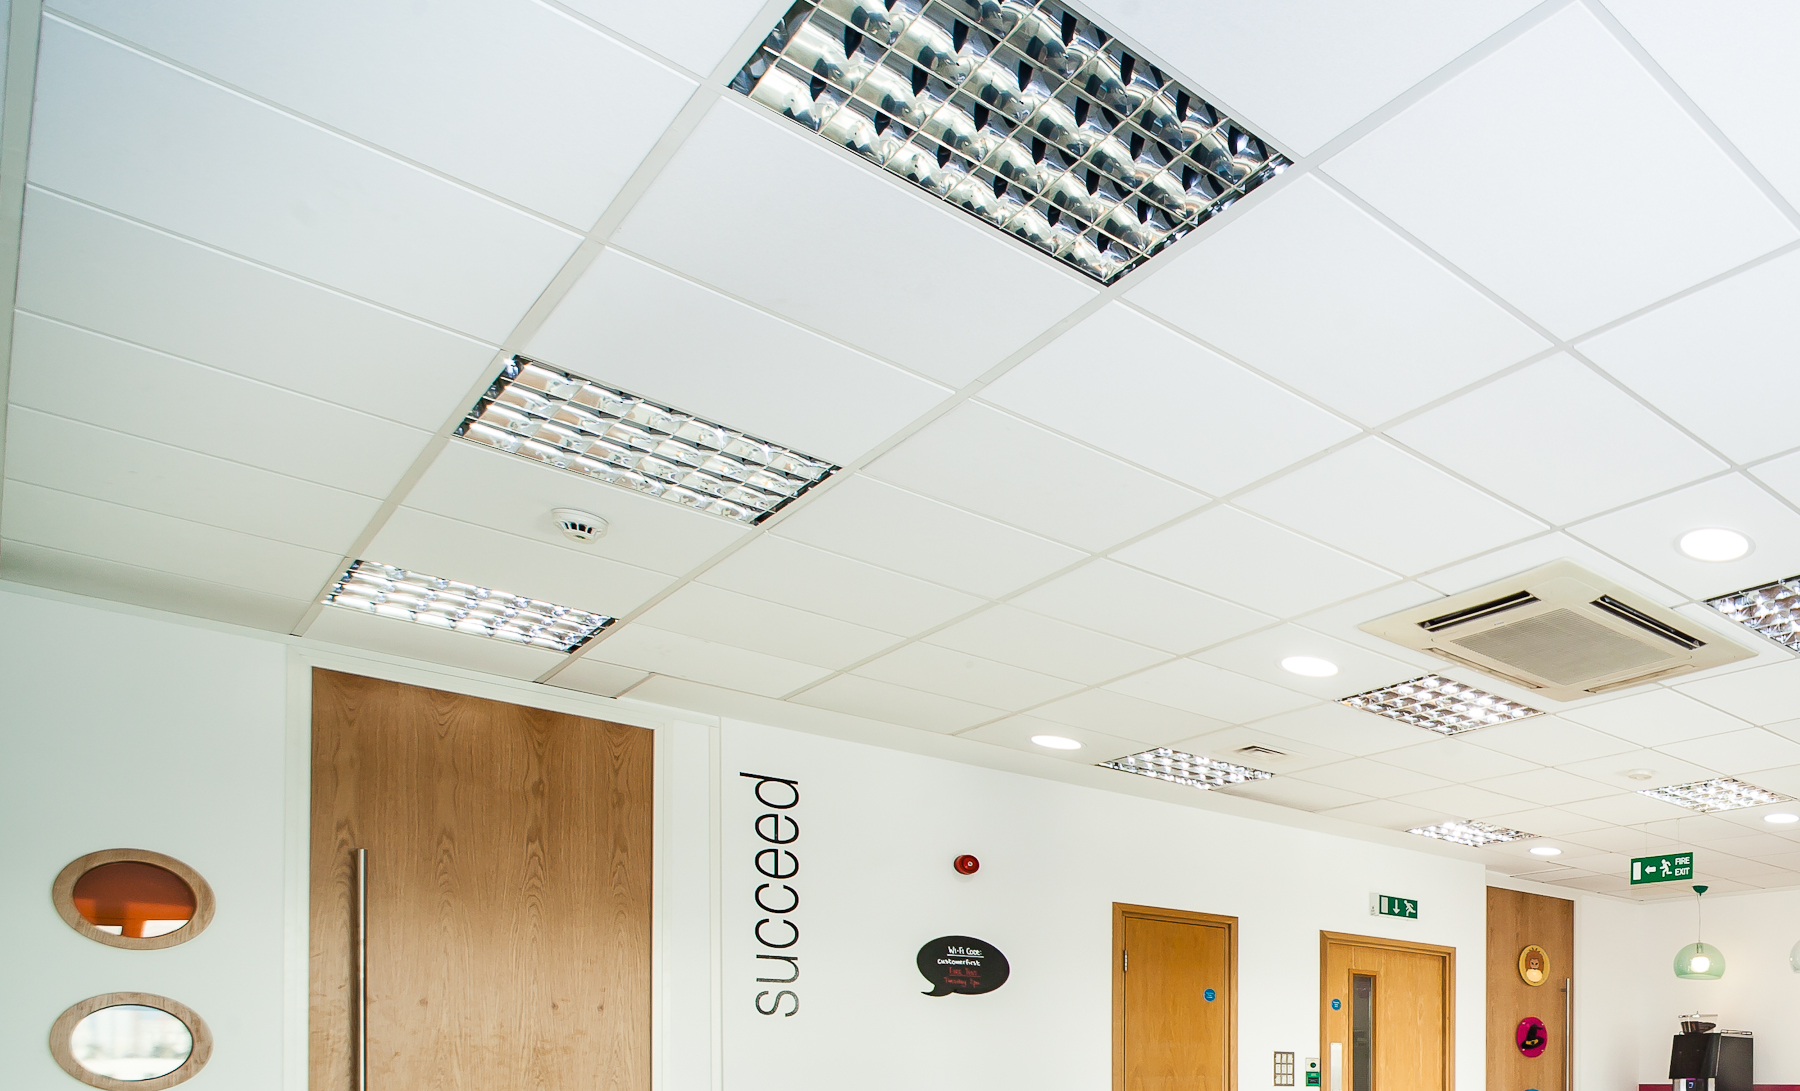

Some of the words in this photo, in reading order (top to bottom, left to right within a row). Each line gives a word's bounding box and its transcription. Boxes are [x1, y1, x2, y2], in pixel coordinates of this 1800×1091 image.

[1674, 856, 1691, 866] FIRE
[1674, 866, 1691, 877] EXIT
[738, 770, 800, 1018] succeed
